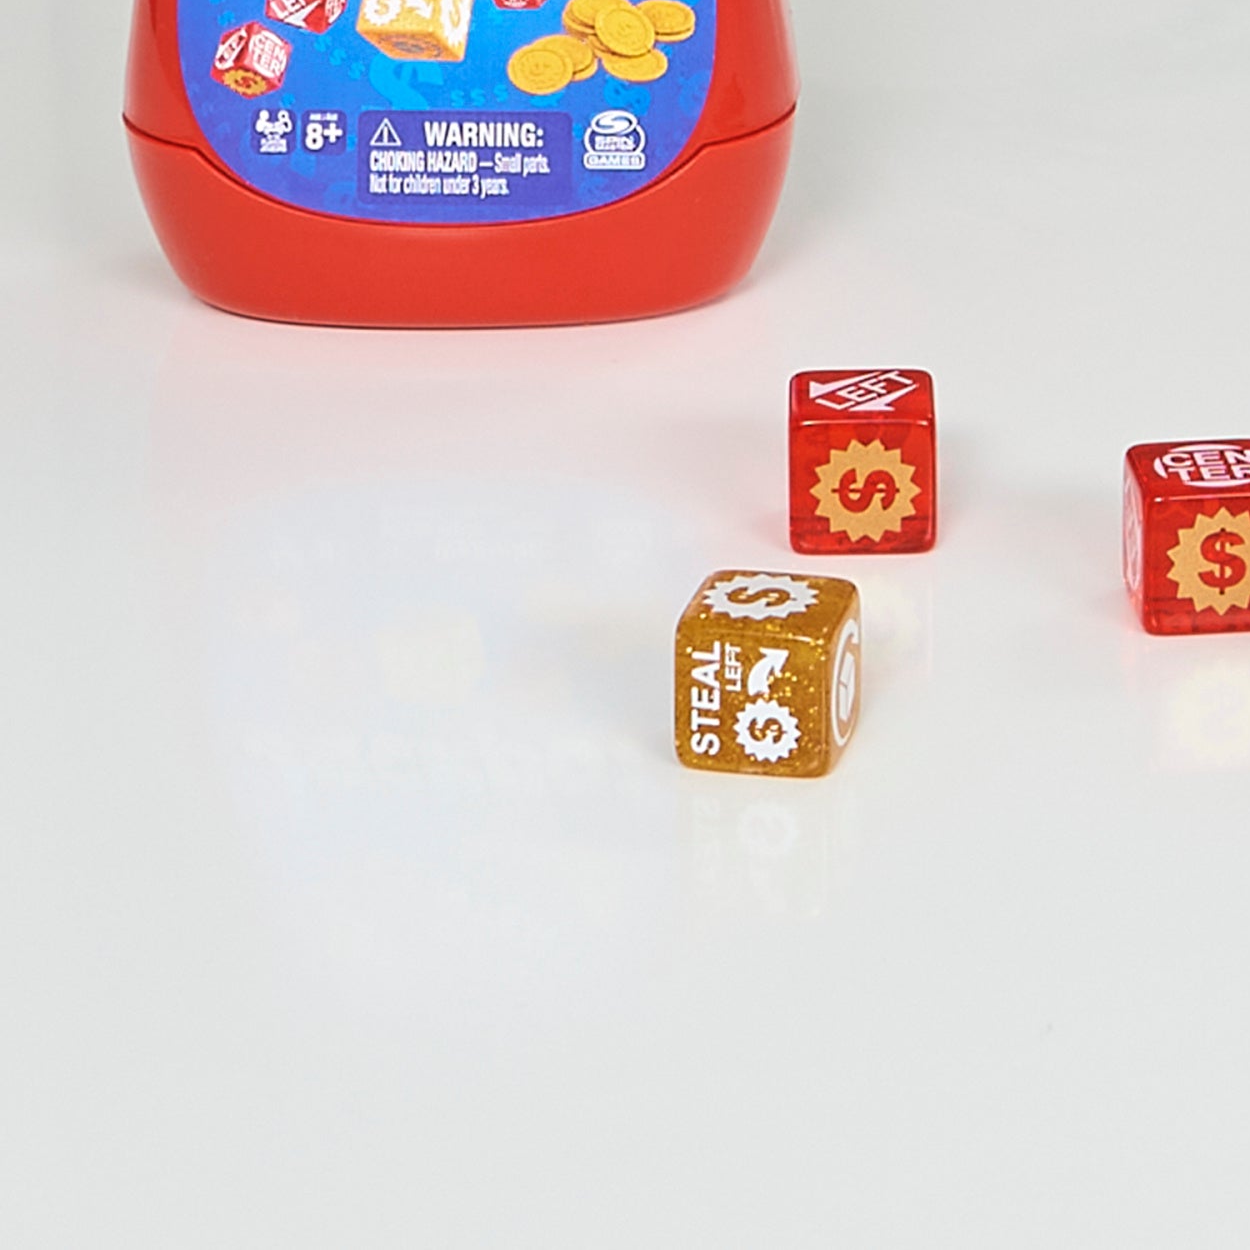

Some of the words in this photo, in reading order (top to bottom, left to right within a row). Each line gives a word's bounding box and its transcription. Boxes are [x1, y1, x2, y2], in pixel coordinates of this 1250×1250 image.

[254, 34, 286, 62] CEN
[252, 50, 282, 78] TER
[304, 121, 344, 151] 8+
[423, 120, 545, 148] WARNING:
[369, 150, 425, 173] CHOKING
[426, 150, 478, 173] HAZARD
[494, 152, 522, 173] Small
[403, 173, 442, 195] children
[472, 174, 480, 196] 3
[814, 370, 914, 411] LEFT
[1197, 526, 1248, 596] $
[724, 641, 743, 692] LEFT
[690, 640, 722, 756] STEAL
